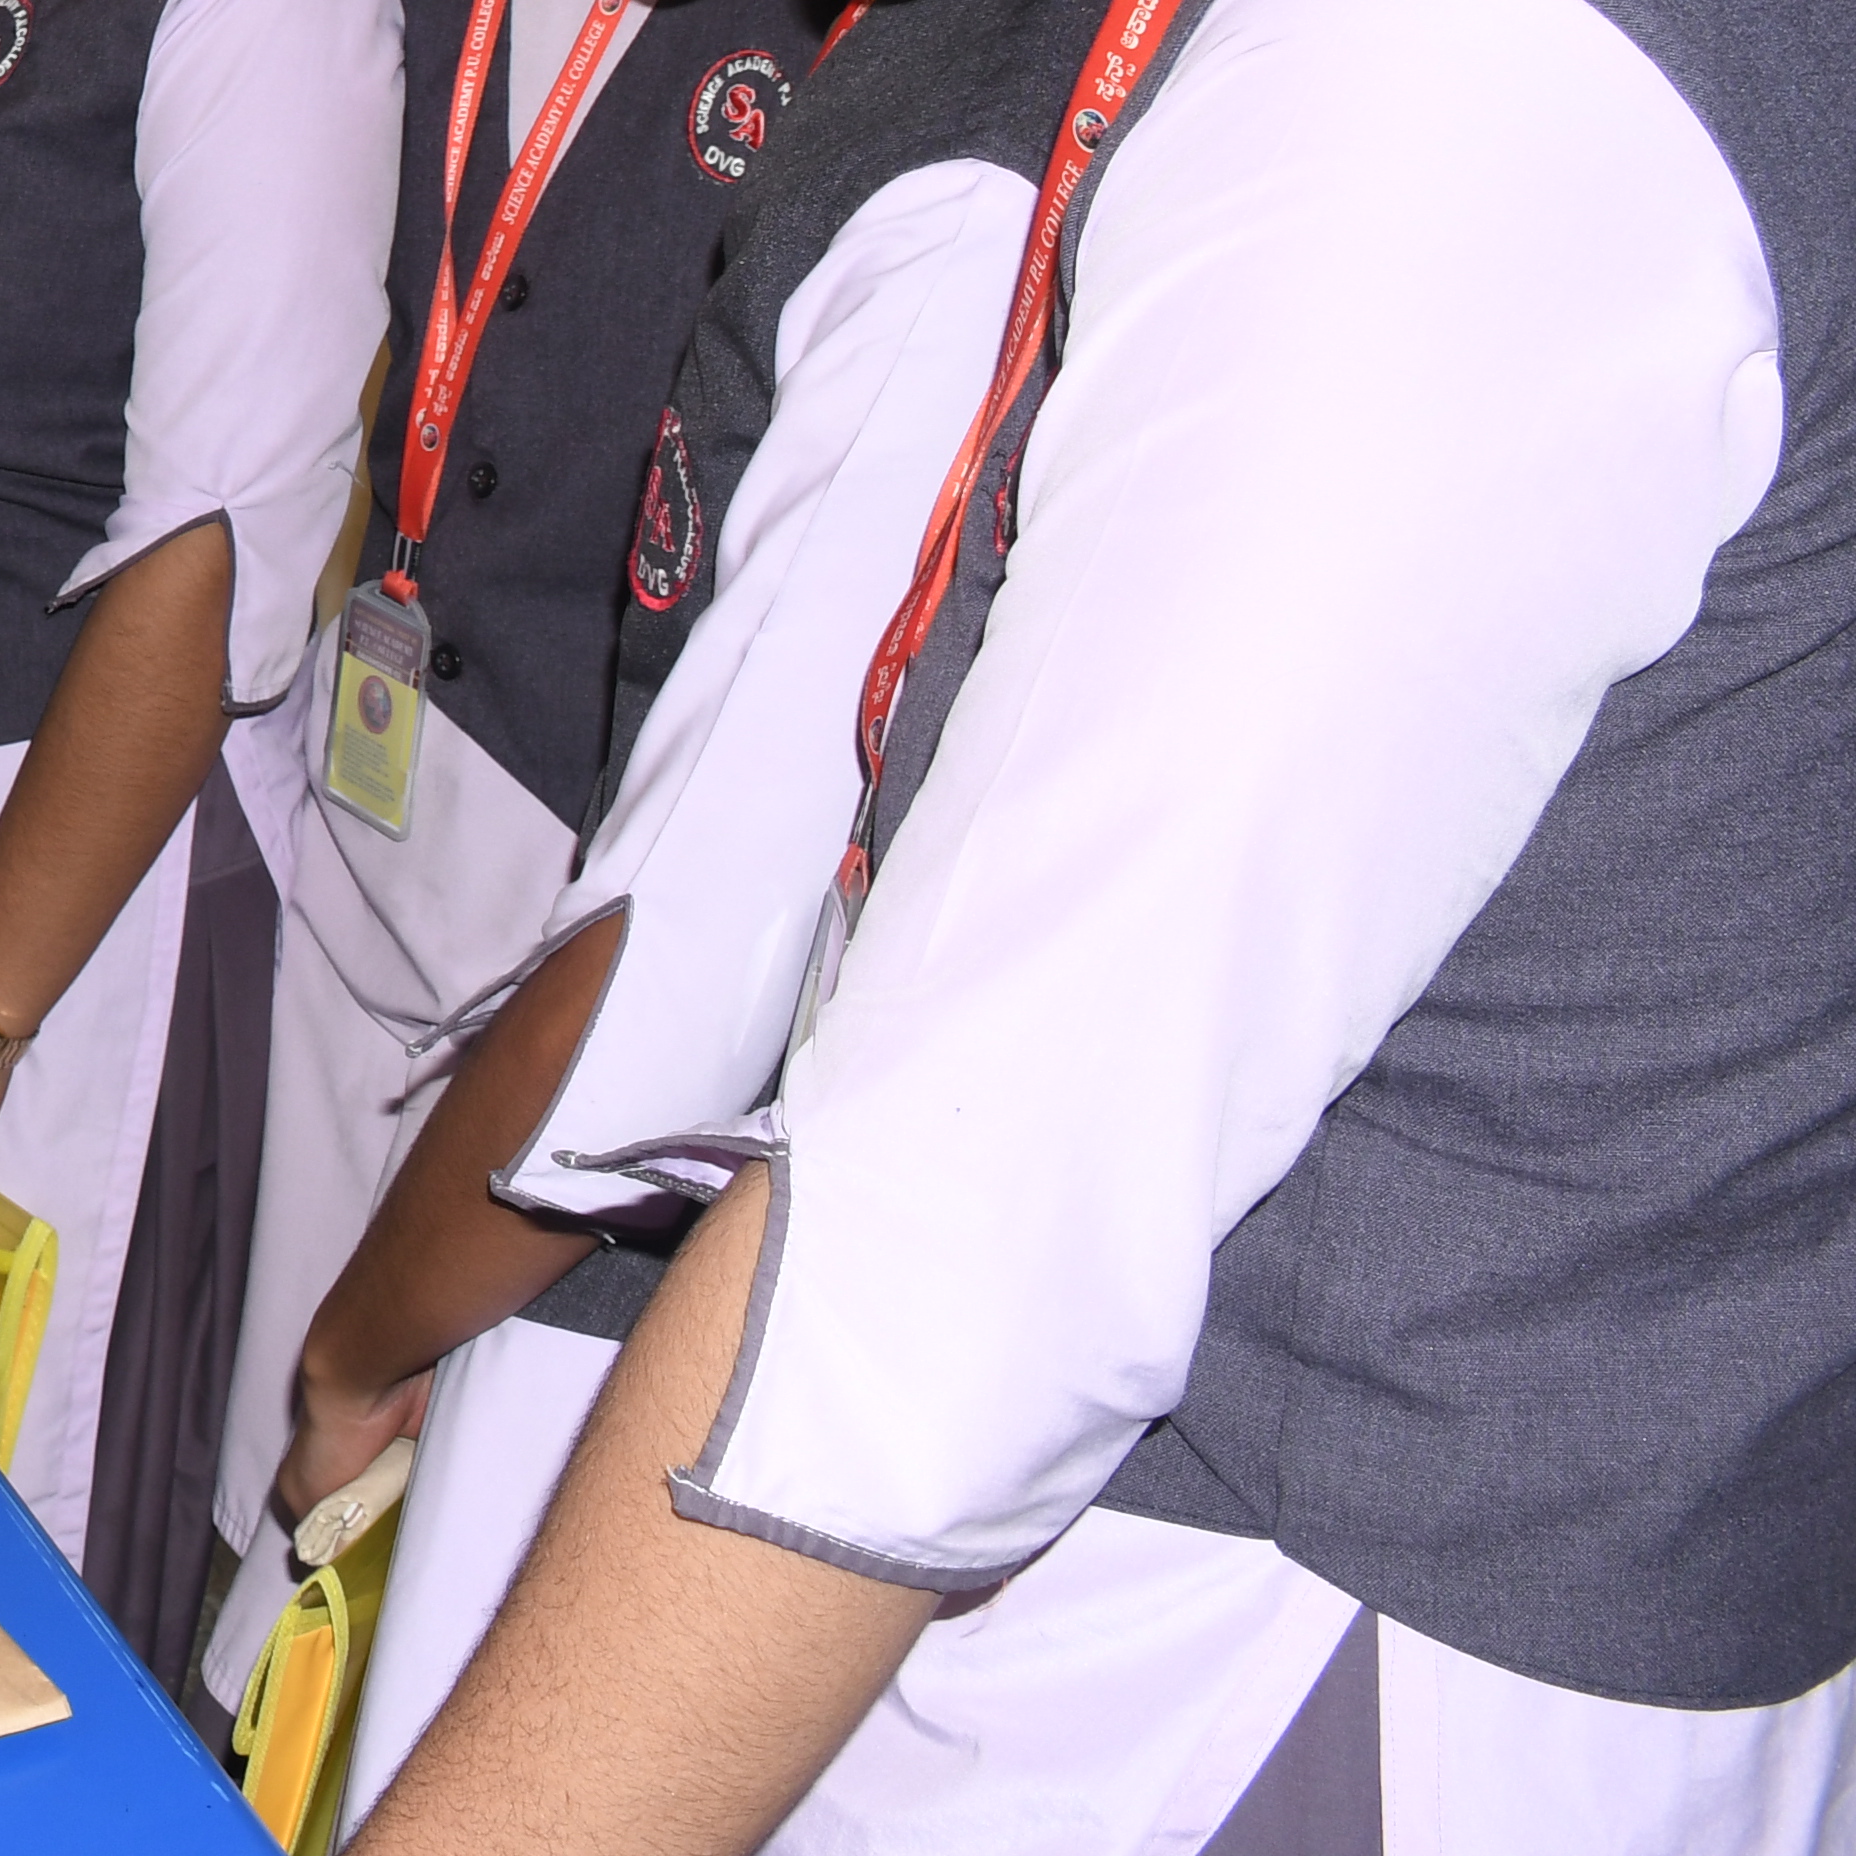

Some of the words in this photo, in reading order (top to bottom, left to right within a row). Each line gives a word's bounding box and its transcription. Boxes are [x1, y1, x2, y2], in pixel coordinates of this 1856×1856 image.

[463, 52, 482, 79] P.U.
[454, 76, 477, 145] ACADEMY
[500, 165, 536, 227] SCIENCE
[528, 103, 564, 171] ACADEMY
[554, 81, 578, 108] P.U.
[568, 18, 607, 82] COLLEGE
[696, 74, 726, 135] SCIENCE
[445, 146, 462, 205] SCIENCE
[704, 145, 747, 178] DVG
[1039, 158, 1086, 251] COLLEGE
